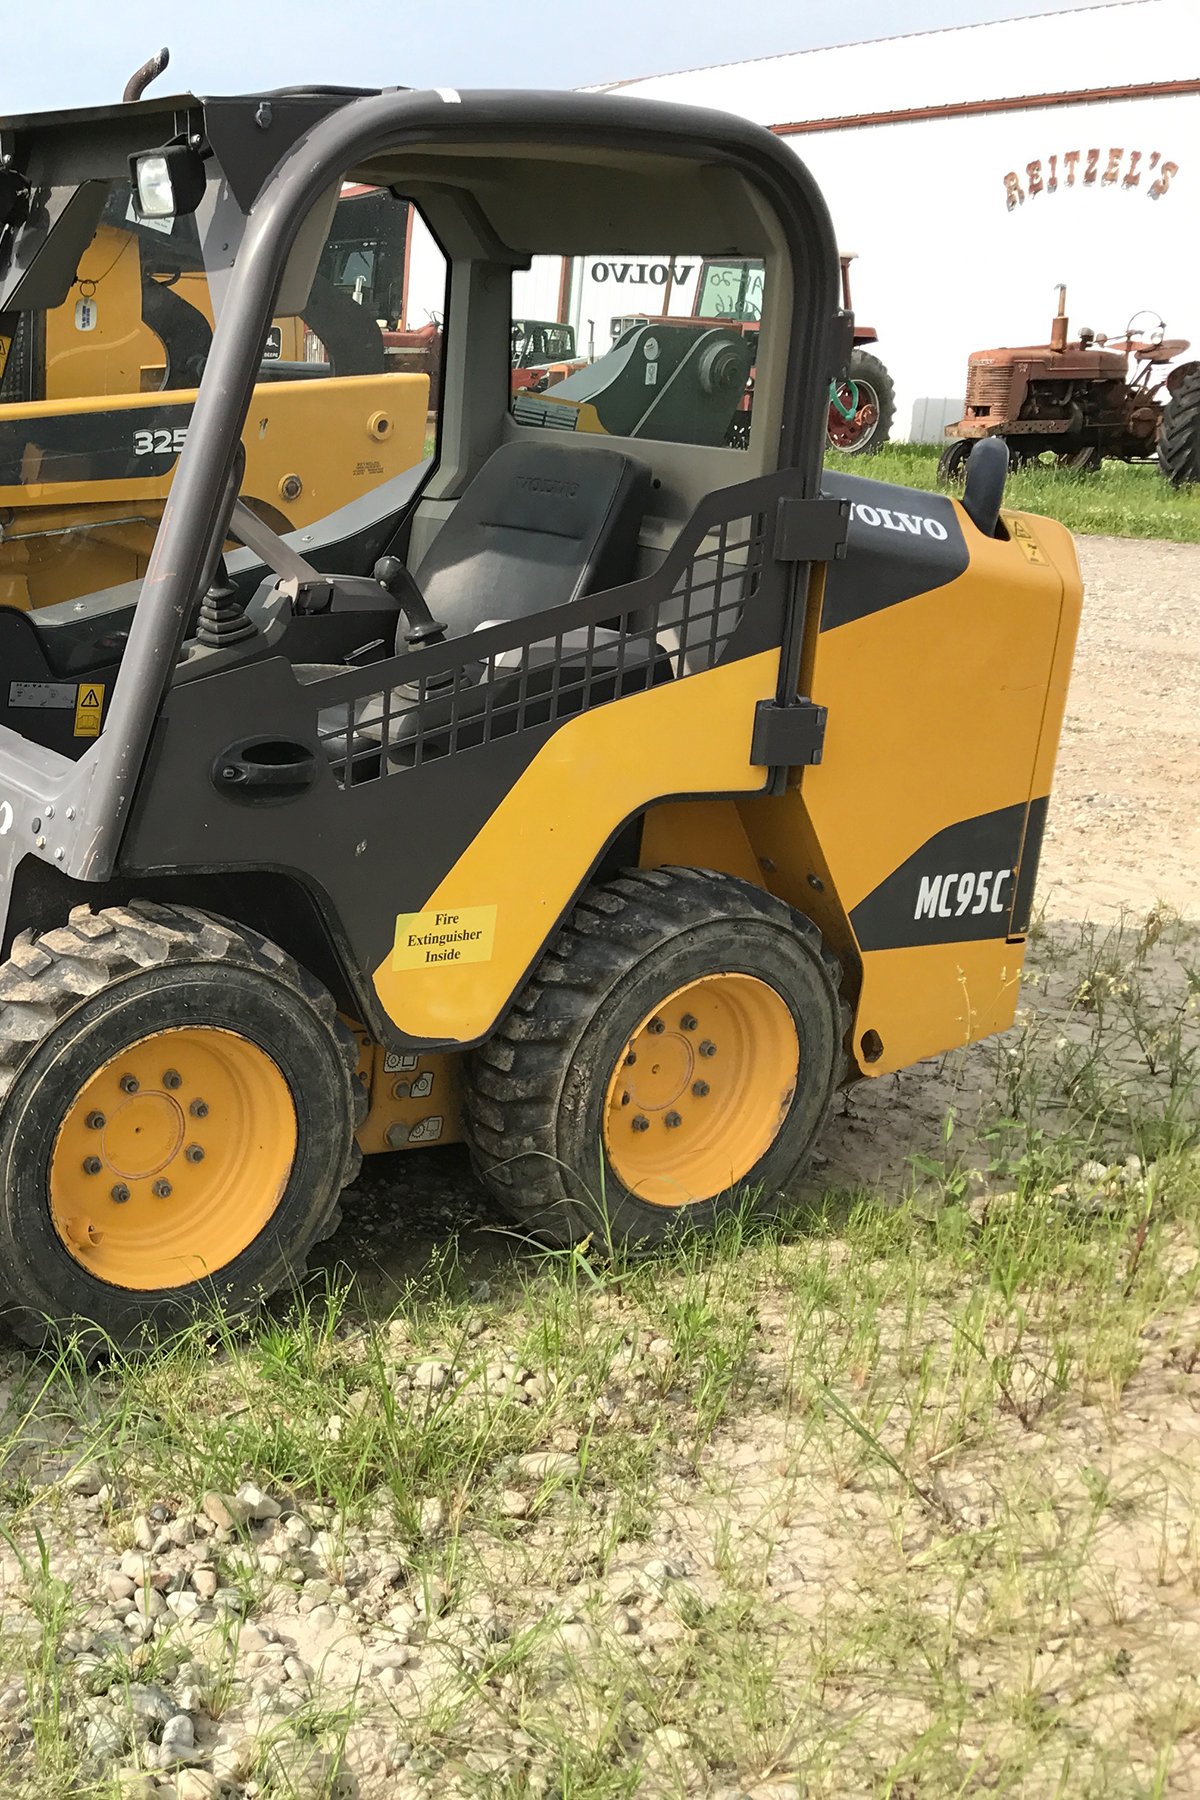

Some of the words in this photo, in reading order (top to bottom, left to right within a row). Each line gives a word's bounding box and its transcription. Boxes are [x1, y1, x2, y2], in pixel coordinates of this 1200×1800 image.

[1003, 147, 1179, 212] REITZEL'S
[914, 869, 1011, 920] MC95C
[434, 913, 460, 926] Fire
[407, 930, 483, 947] Extinguisher
[424, 948, 461, 963] Inside
